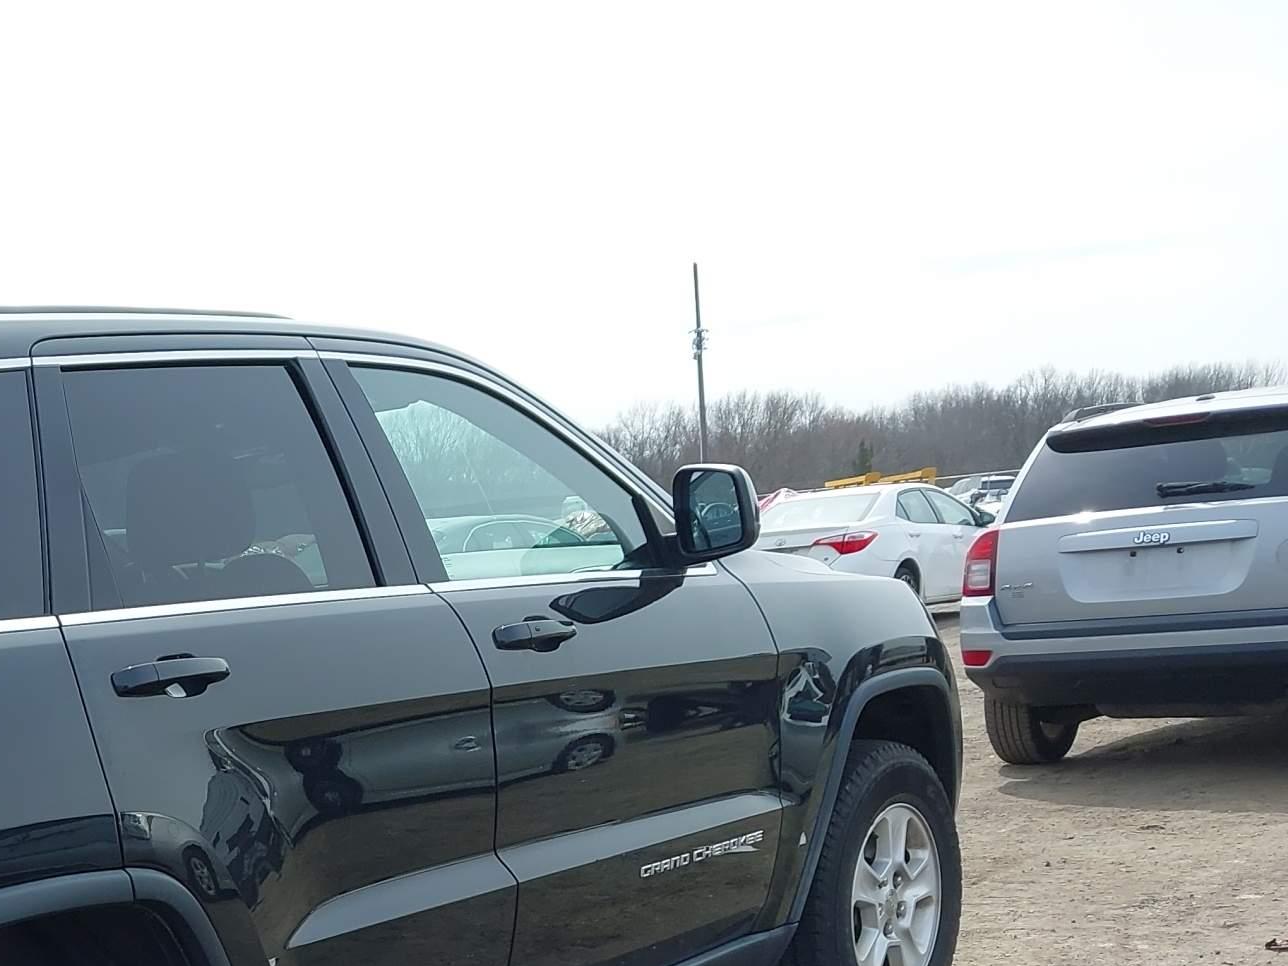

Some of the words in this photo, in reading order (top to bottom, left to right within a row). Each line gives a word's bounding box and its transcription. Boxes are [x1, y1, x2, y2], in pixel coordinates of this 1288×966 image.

[1133, 531, 1170, 544] Jeep
[640, 852, 691, 878] GRAND
[693, 830, 764, 861] CHEROKEE
